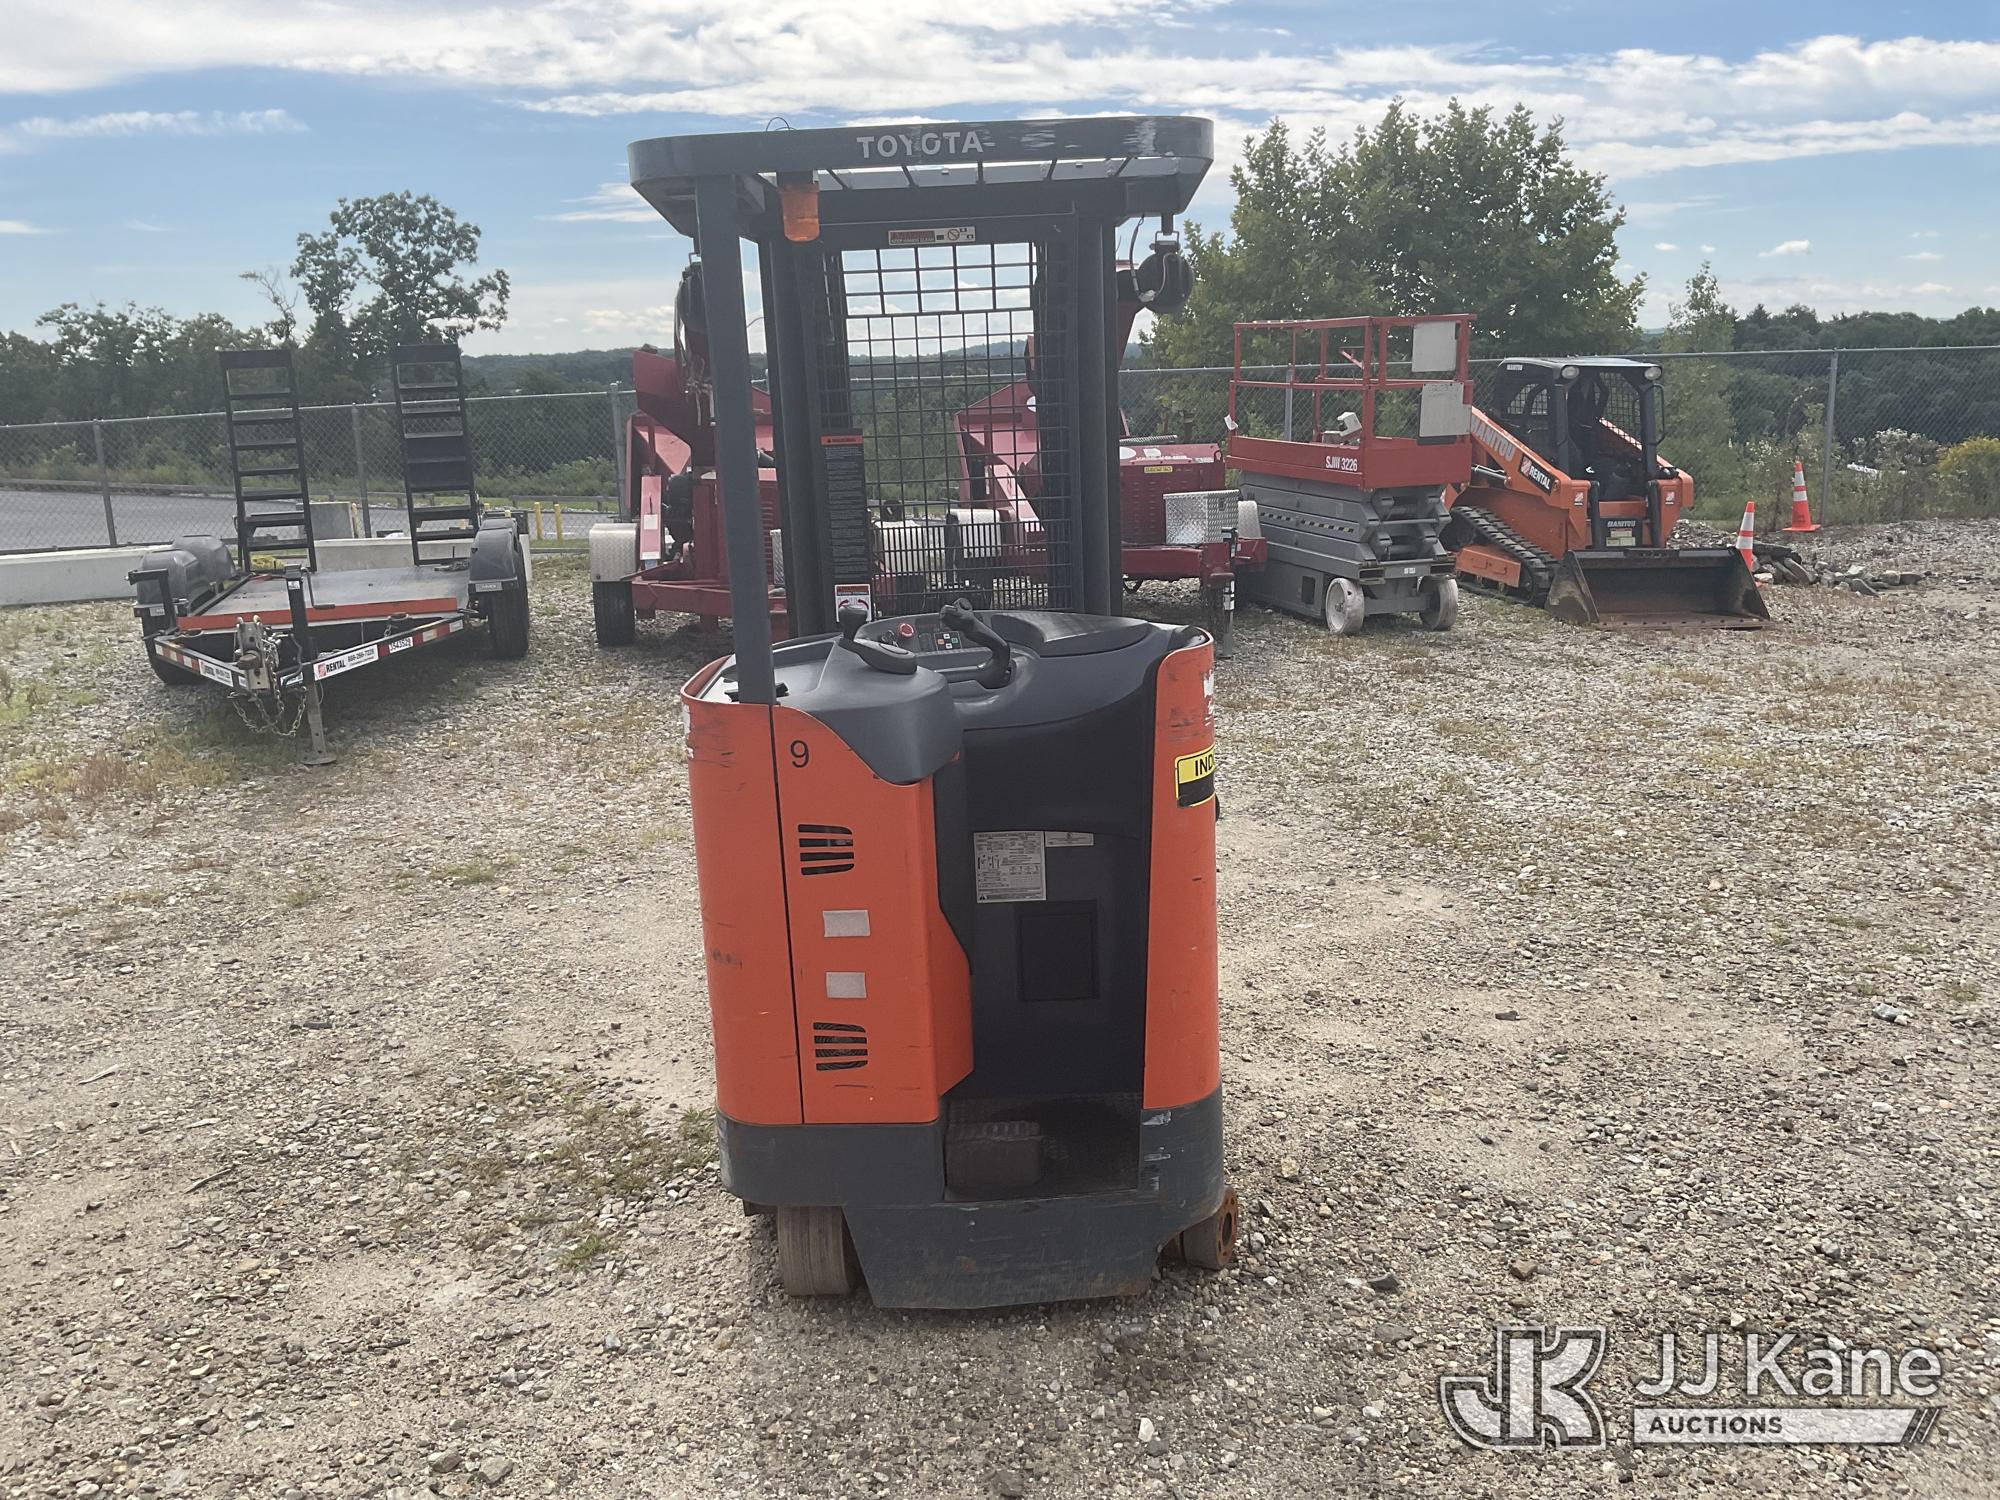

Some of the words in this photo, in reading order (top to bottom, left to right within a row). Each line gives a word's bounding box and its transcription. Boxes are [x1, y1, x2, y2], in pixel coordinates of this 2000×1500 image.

[856, 131, 984, 159] TOYOTA
[1341, 457, 1358, 471] 3226
[1529, 465, 1551, 490] RENTAL
[1607, 520, 1636, 528] MANITOU
[326, 658, 346, 673] RENTAL
[790, 739, 810, 768] 9
